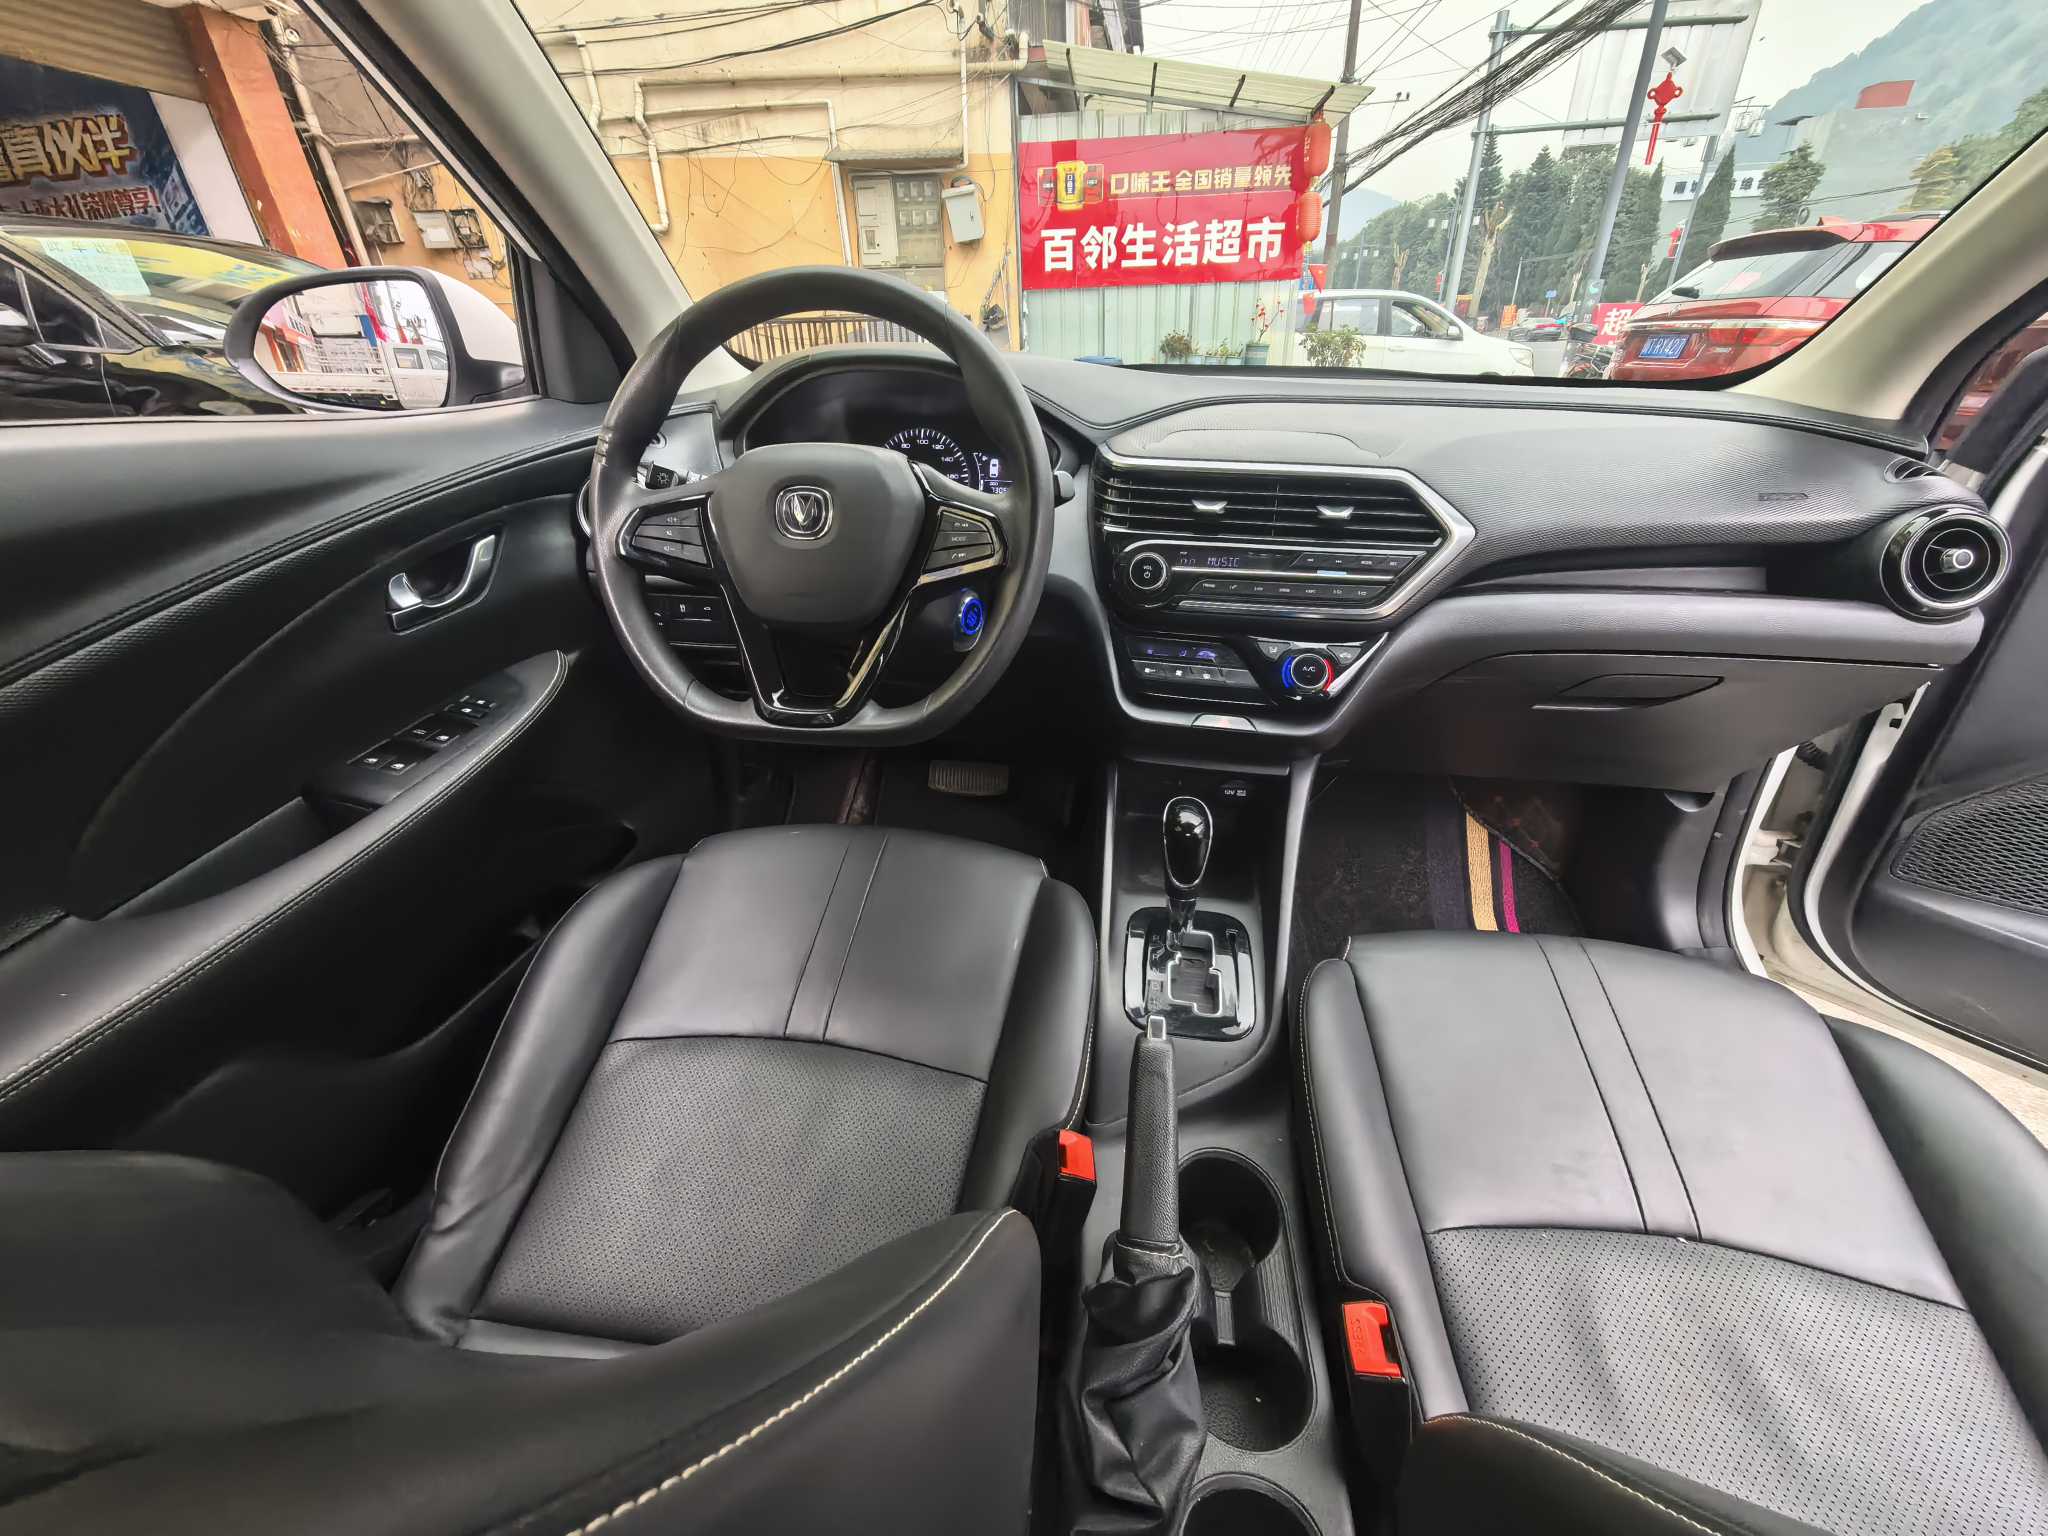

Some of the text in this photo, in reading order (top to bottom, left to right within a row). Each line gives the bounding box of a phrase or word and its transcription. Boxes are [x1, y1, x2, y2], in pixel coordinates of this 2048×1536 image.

[1040, 216, 1286, 272] 百邻生活超市
[1207, 557, 1240, 568] MUSIC
[1302, 665, 1316, 673] A/C
